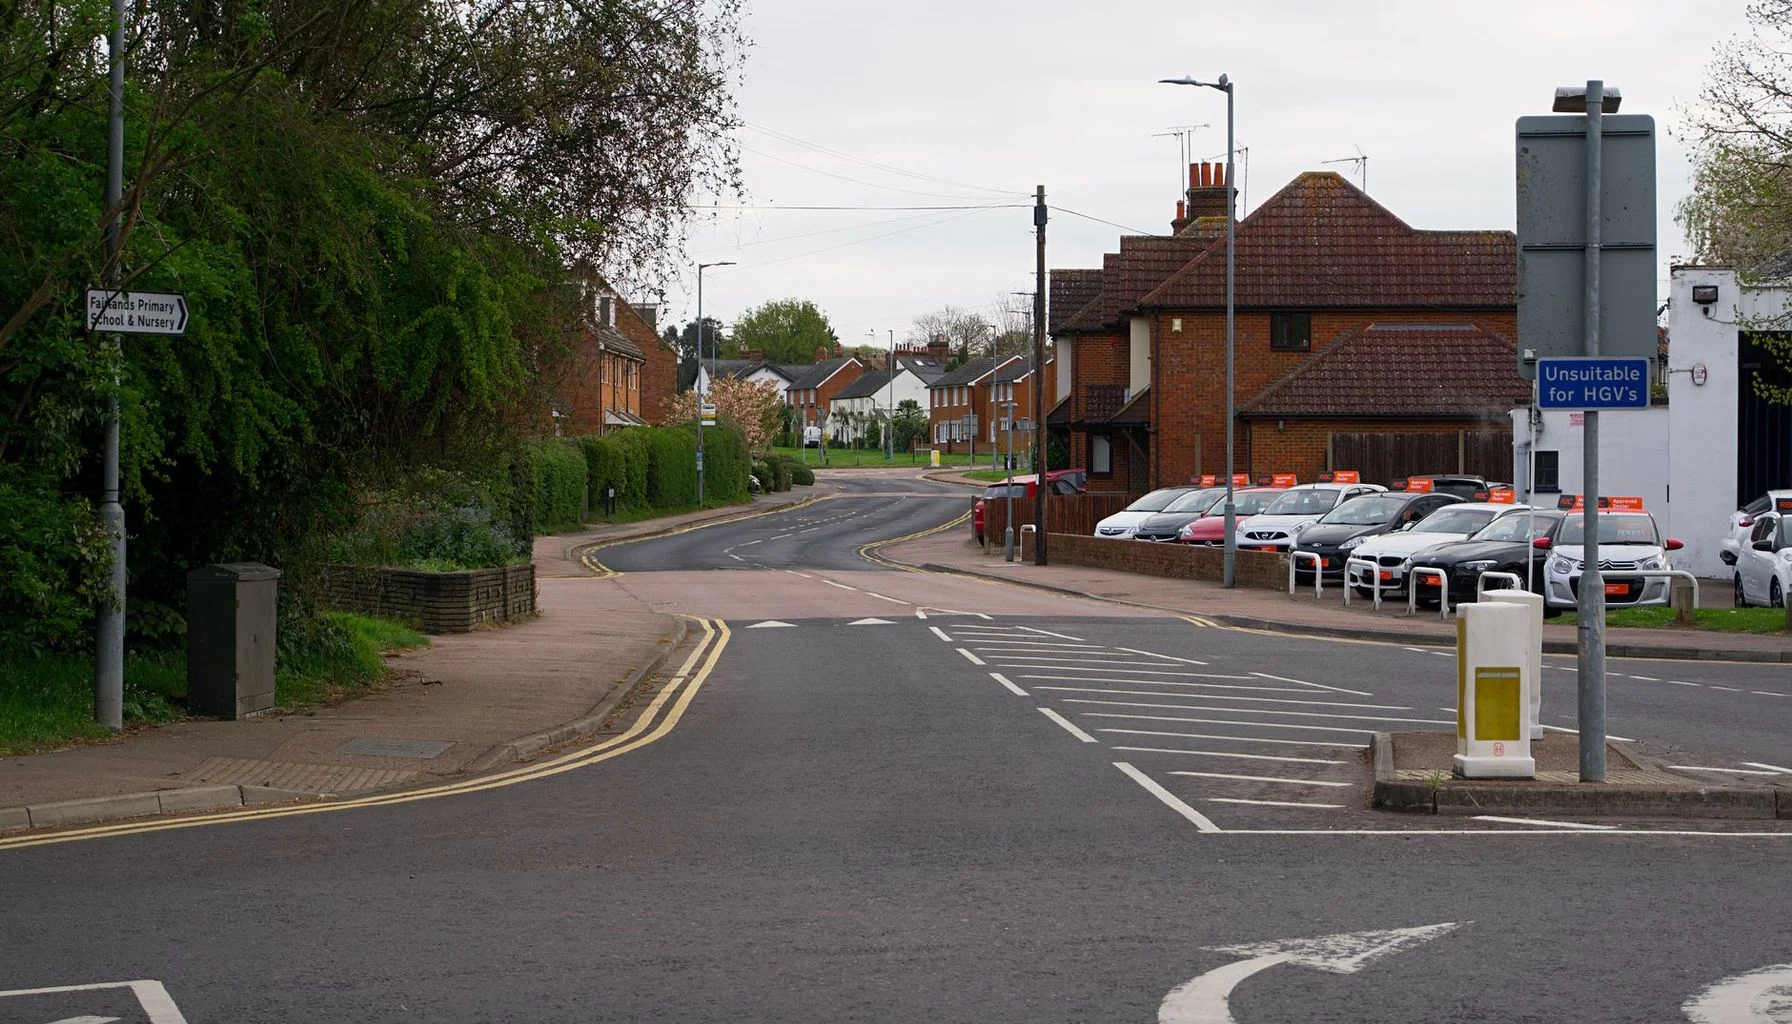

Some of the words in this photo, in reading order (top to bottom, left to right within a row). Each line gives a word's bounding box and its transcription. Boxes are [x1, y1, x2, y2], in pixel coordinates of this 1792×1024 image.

[90, 296, 135, 311] Faiands
[138, 299, 174, 315] Primary
[90, 313, 125, 326] School
[128, 314, 134, 326] &
[138, 315, 175, 331] Nursery
[1545, 366, 1640, 381] Unsuitable
[1549, 387, 1574, 402] for
[1584, 386, 1638, 402] HGV's
